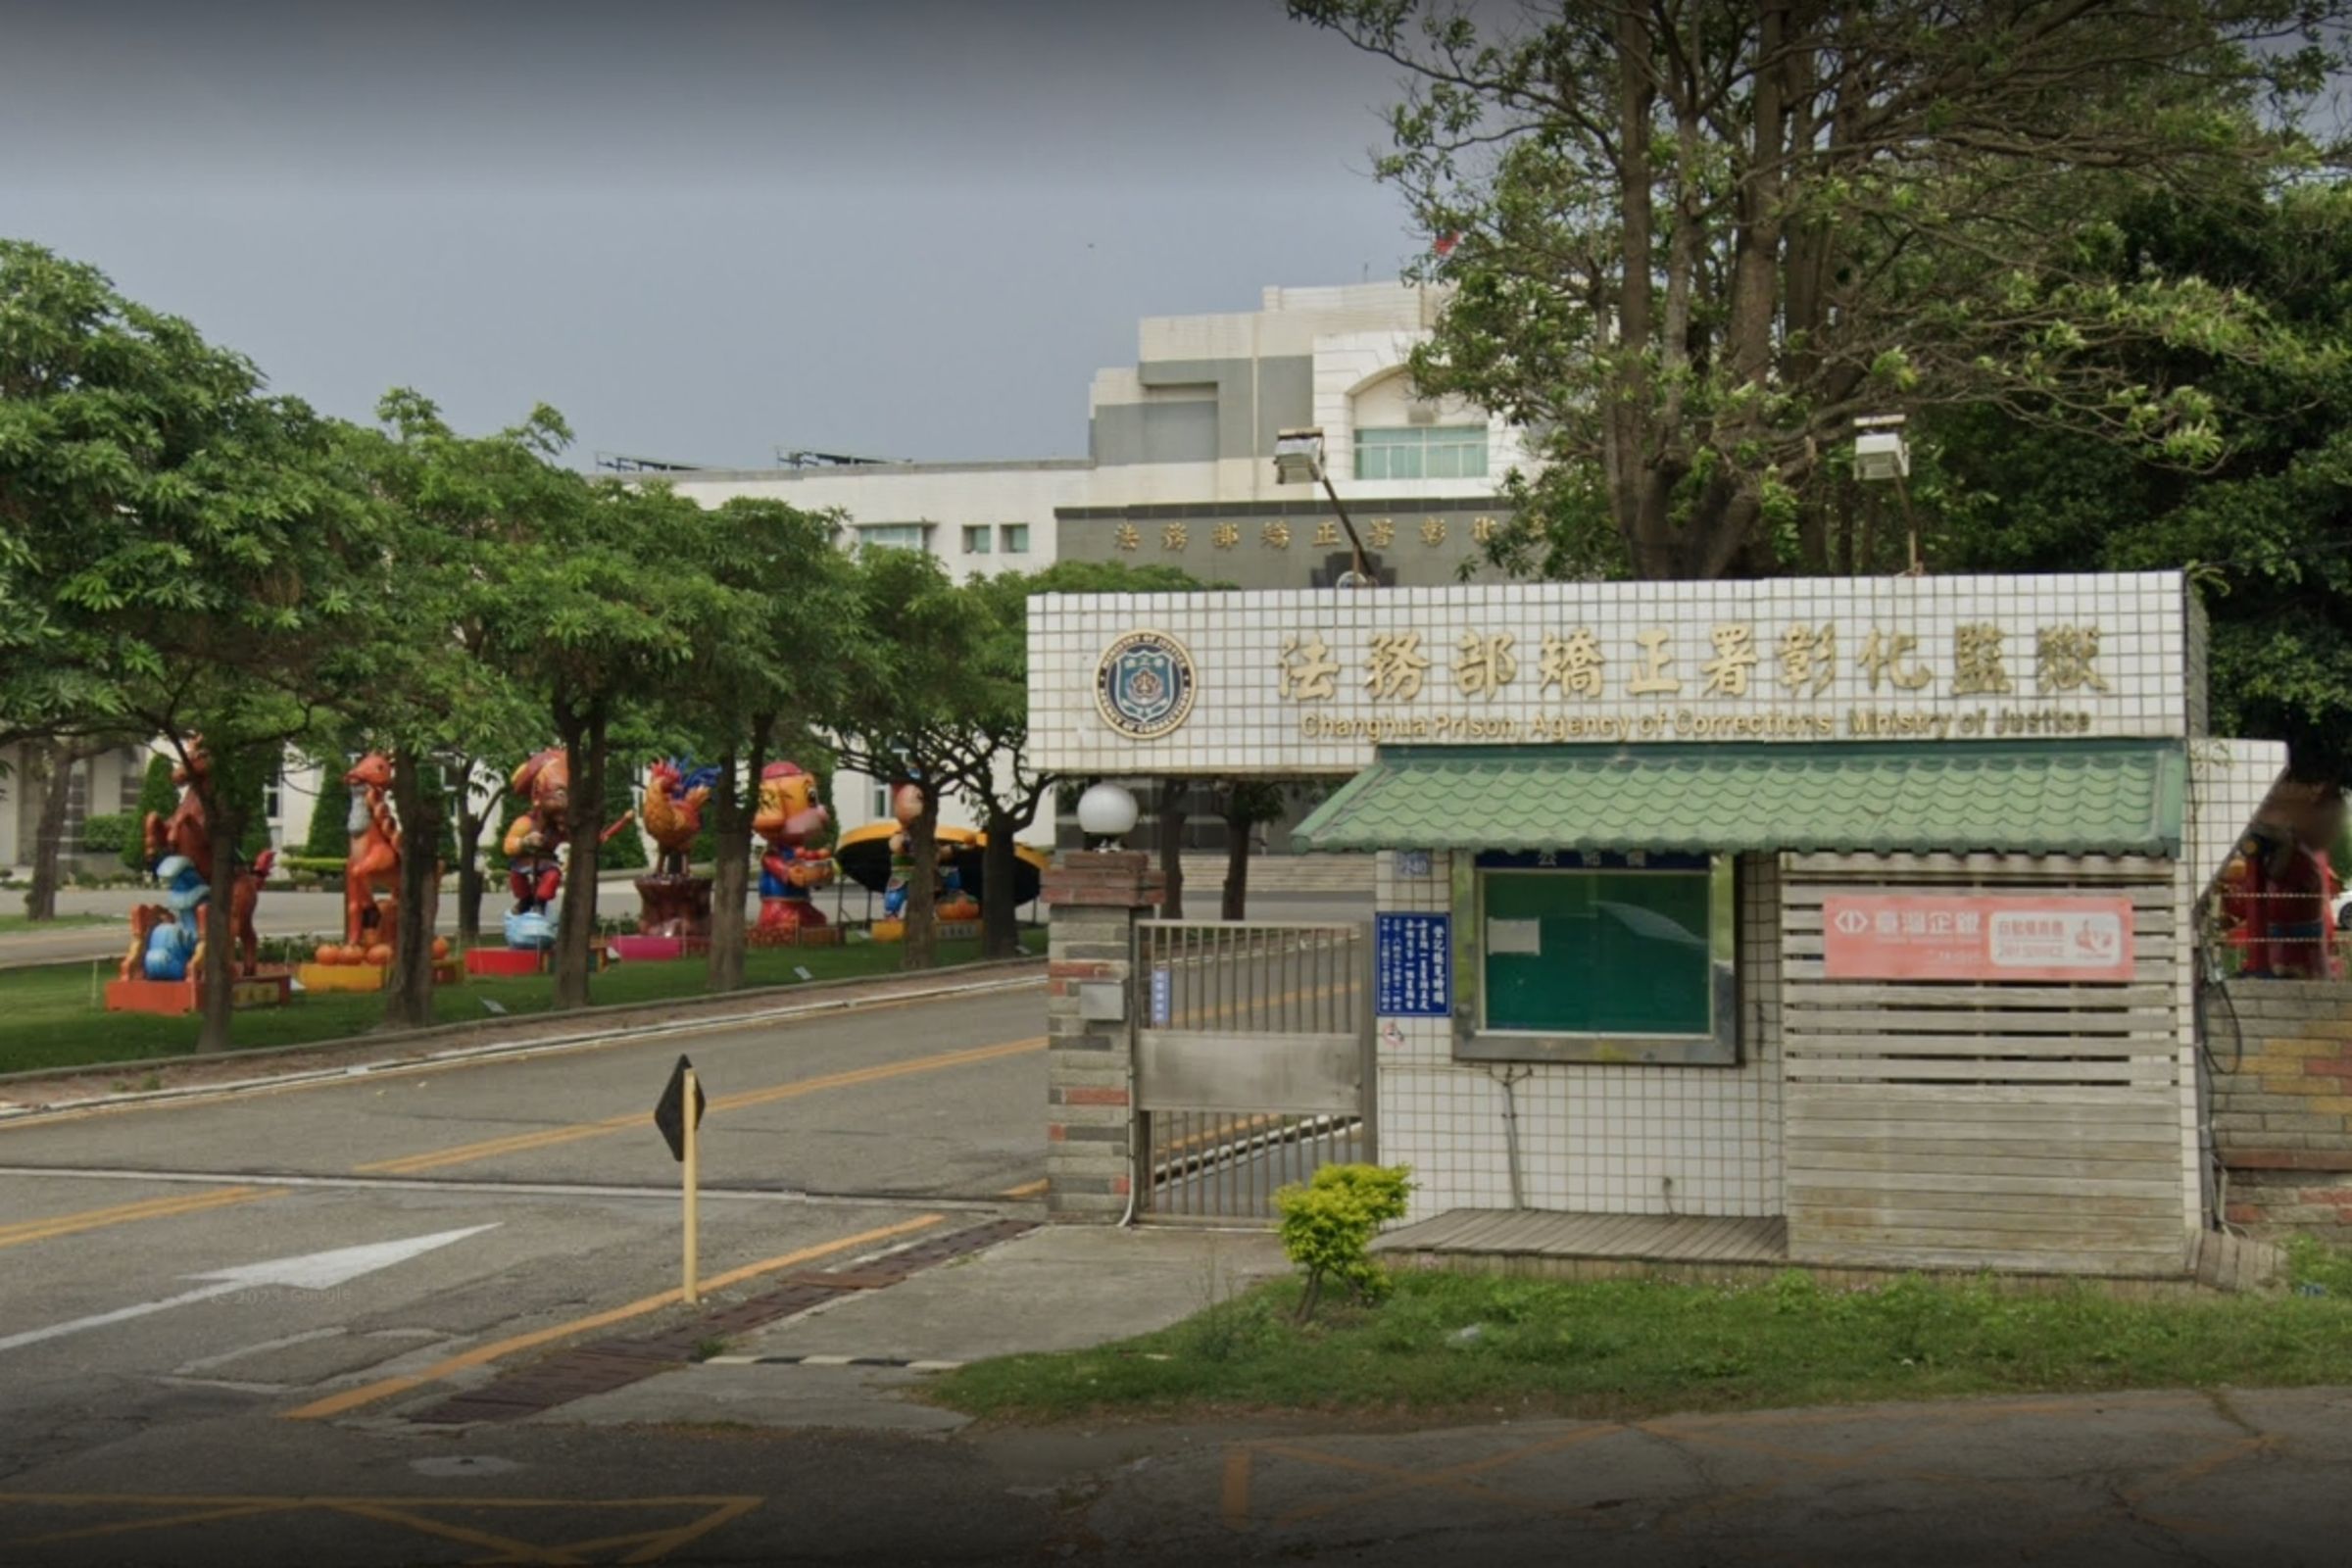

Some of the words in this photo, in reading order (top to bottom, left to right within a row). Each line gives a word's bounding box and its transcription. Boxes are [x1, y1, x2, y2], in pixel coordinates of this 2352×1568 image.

[1278, 625, 2112, 699] 法務部矯正署彰化監獄
[1302, 712, 1427, 743] Changhua
[1533, 712, 1631, 743] Agency
[1639, 711, 1667, 734] of
[1674, 710, 1835, 735] Corrections
[1848, 709, 1952, 741] Ministry
[1959, 709, 1987, 733] of
[1994, 709, 2091, 734] Justice
